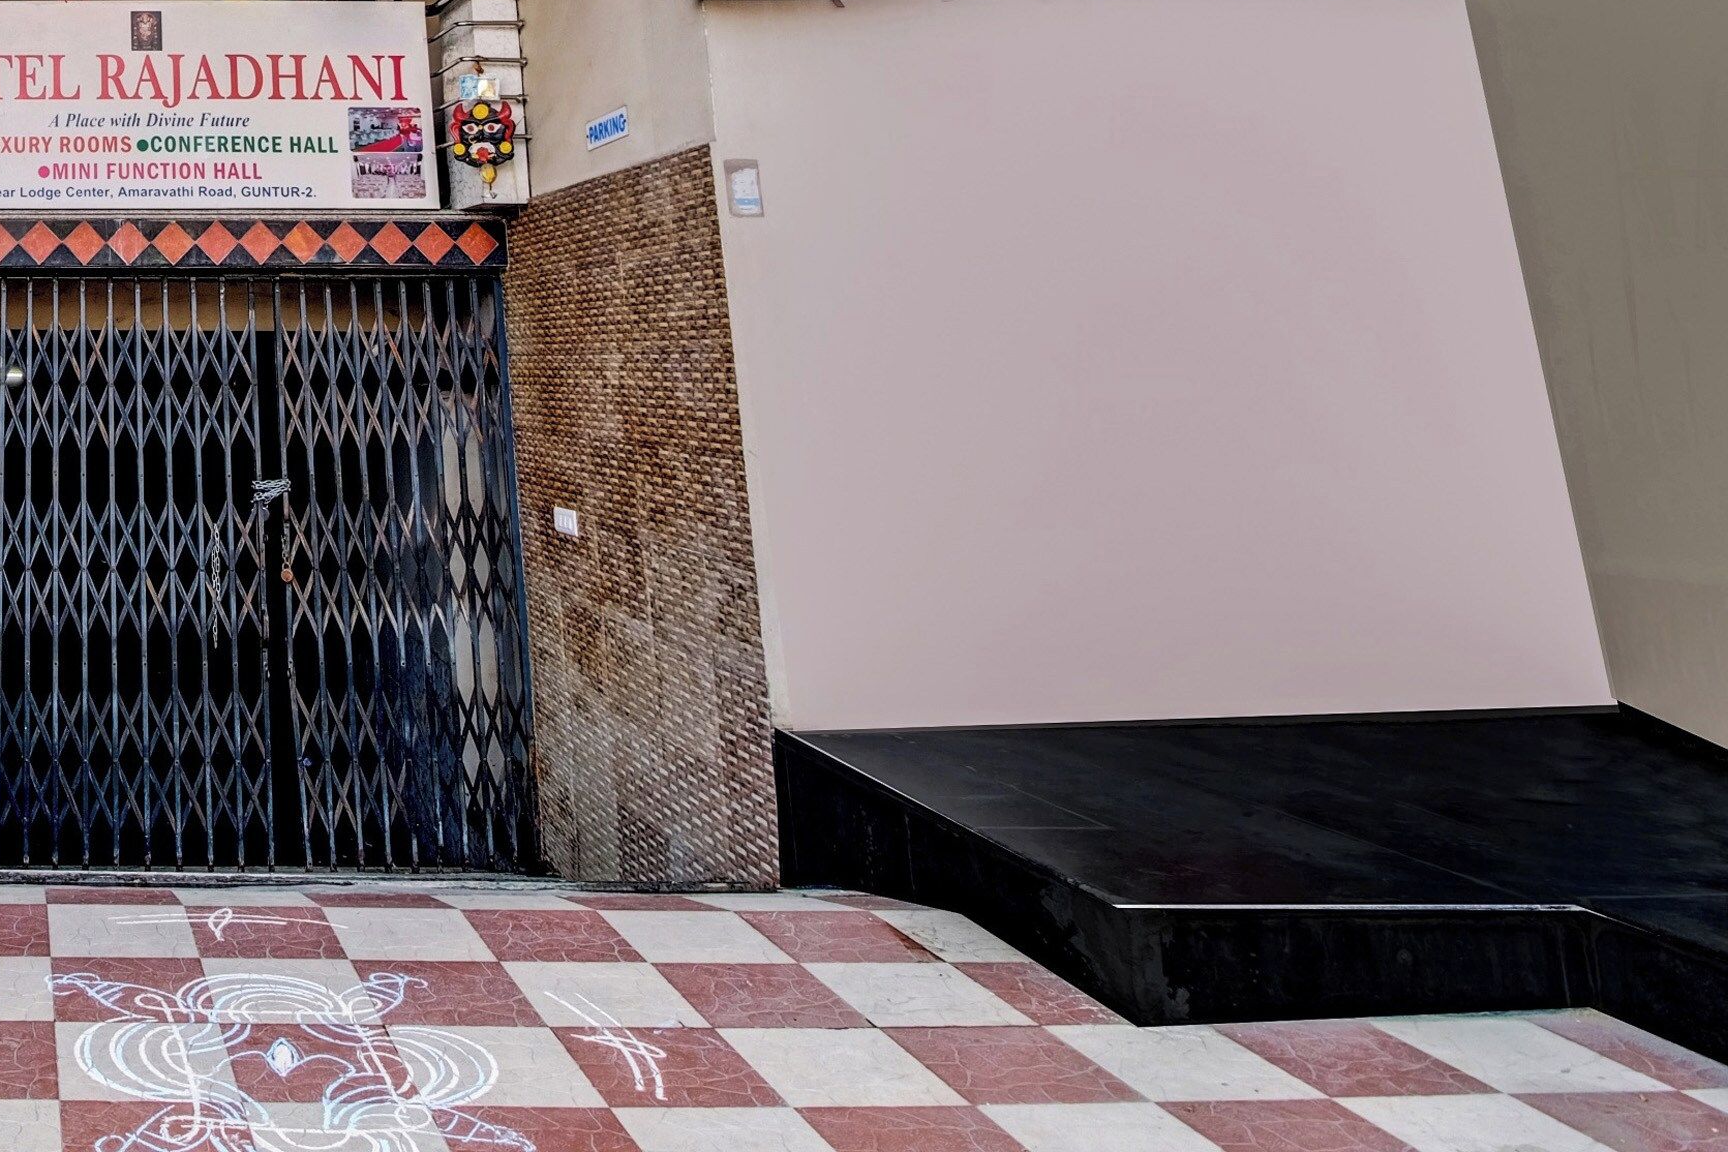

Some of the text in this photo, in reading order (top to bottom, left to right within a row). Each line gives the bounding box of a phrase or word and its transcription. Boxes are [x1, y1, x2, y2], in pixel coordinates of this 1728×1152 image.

[96, 54, 408, 108] RAJADHANI
[47, 113, 249, 127] A Place with Divine Future
[588, 113, 626, 144] PARKING
[60, 136, 131, 153] ROOMS
[151, 136, 282, 153] CONFERENCE
[290, 137, 338, 153] HALL
[52, 162, 262, 179] MINI FUNCTION HALL
[20, 187, 61, 200] Lodge
[66, 187, 113, 199] Center,
[118, 186, 193, 197] Amaravathi
[199, 186, 236, 198] Road,
[241, 186, 316, 197] GUNTUR-2.
